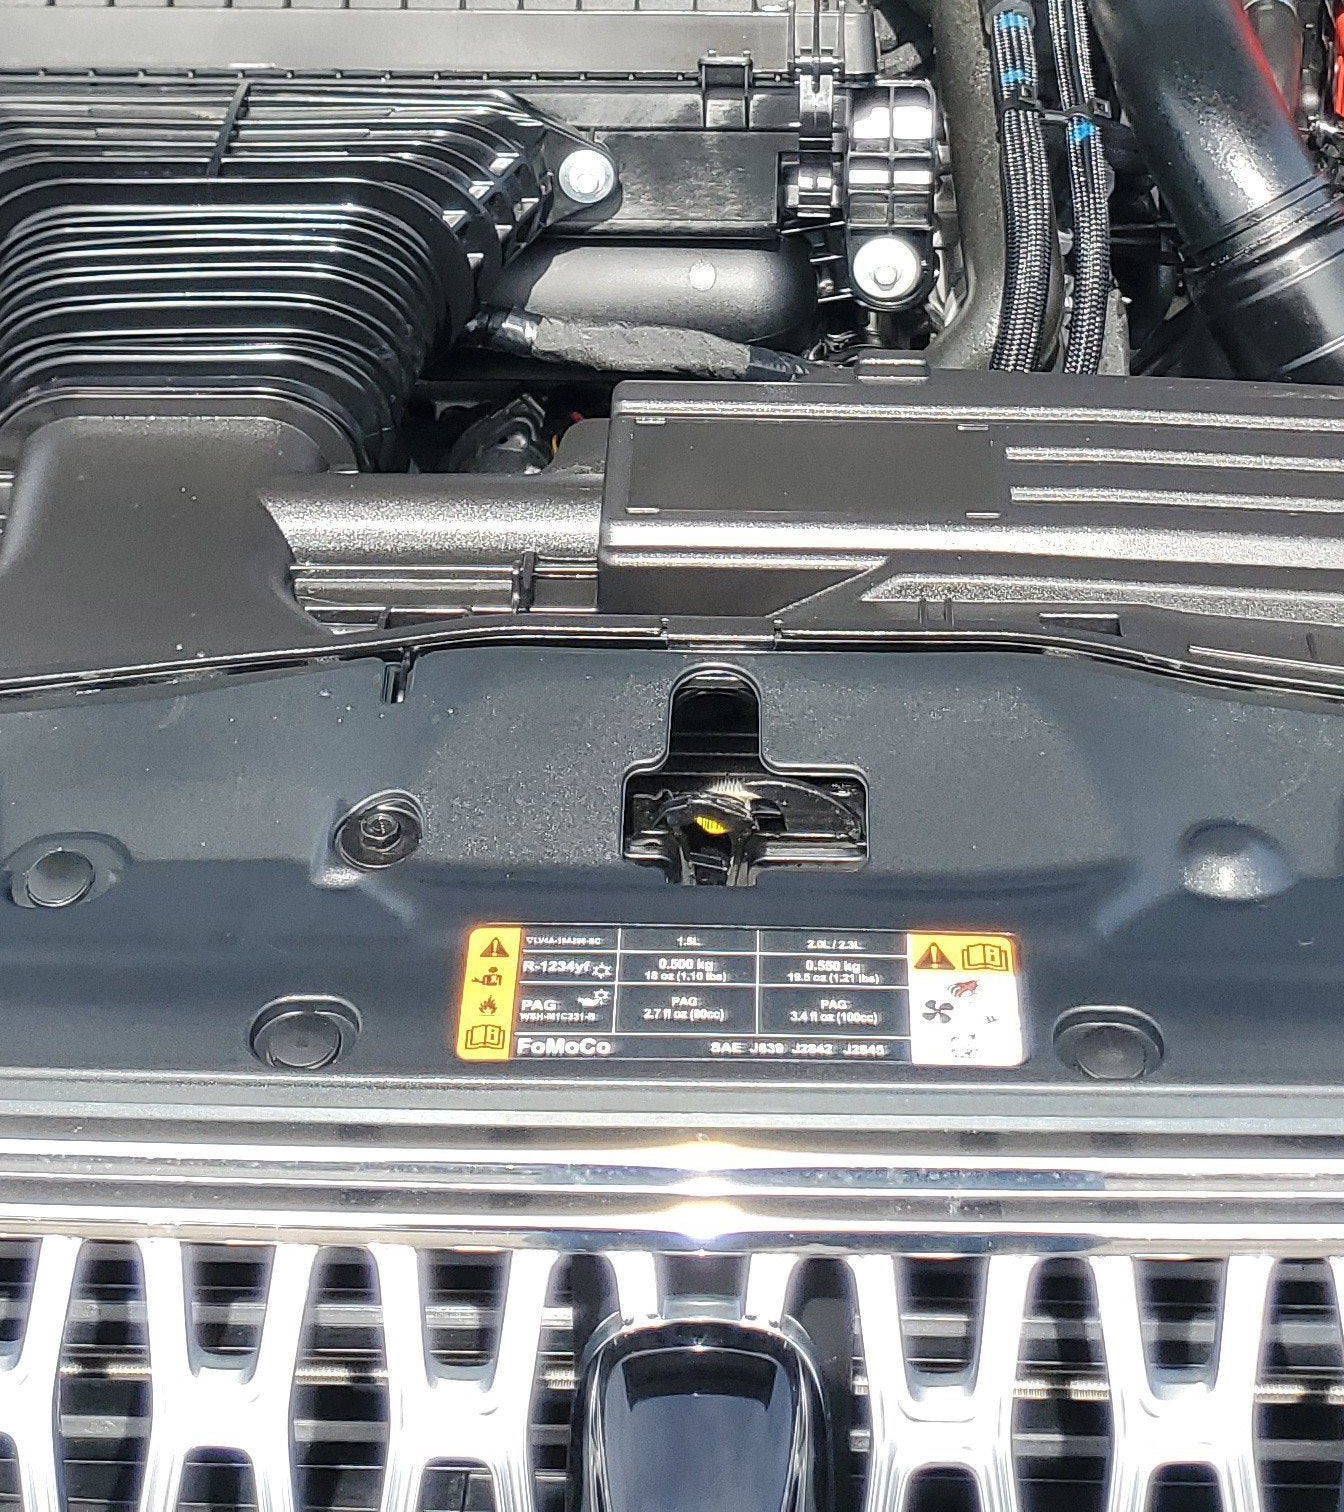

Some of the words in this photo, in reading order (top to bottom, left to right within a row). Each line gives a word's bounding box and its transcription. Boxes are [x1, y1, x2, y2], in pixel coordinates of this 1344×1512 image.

[807, 939, 831, 949] 2.0L
[522, 960, 591, 974] R-1234yf
[658, 958, 694, 970] 0.500
[696, 958, 714, 972] kg
[805, 959, 841, 971] 0.550
[843, 960, 861, 975] kg
[660, 971, 676, 981] oz
[705, 970, 727, 983] lbs)
[812, 973, 828, 982] oz
[858, 973, 880, 985] lbs)
[521, 999, 558, 1012] PAG
[671, 996, 698, 1007] PAG
[820, 999, 849, 1010] PAG
[642, 1008, 662, 1021] 2.7
[673, 1009, 688, 1020] oz
[789, 1010, 808, 1022] 3.4
[819, 1012, 835, 1022] oz
[836, 1011, 878, 1026] (100cc)
[516, 1037, 612, 1057] FoMoCo
[710, 1041, 744, 1054] SAE
